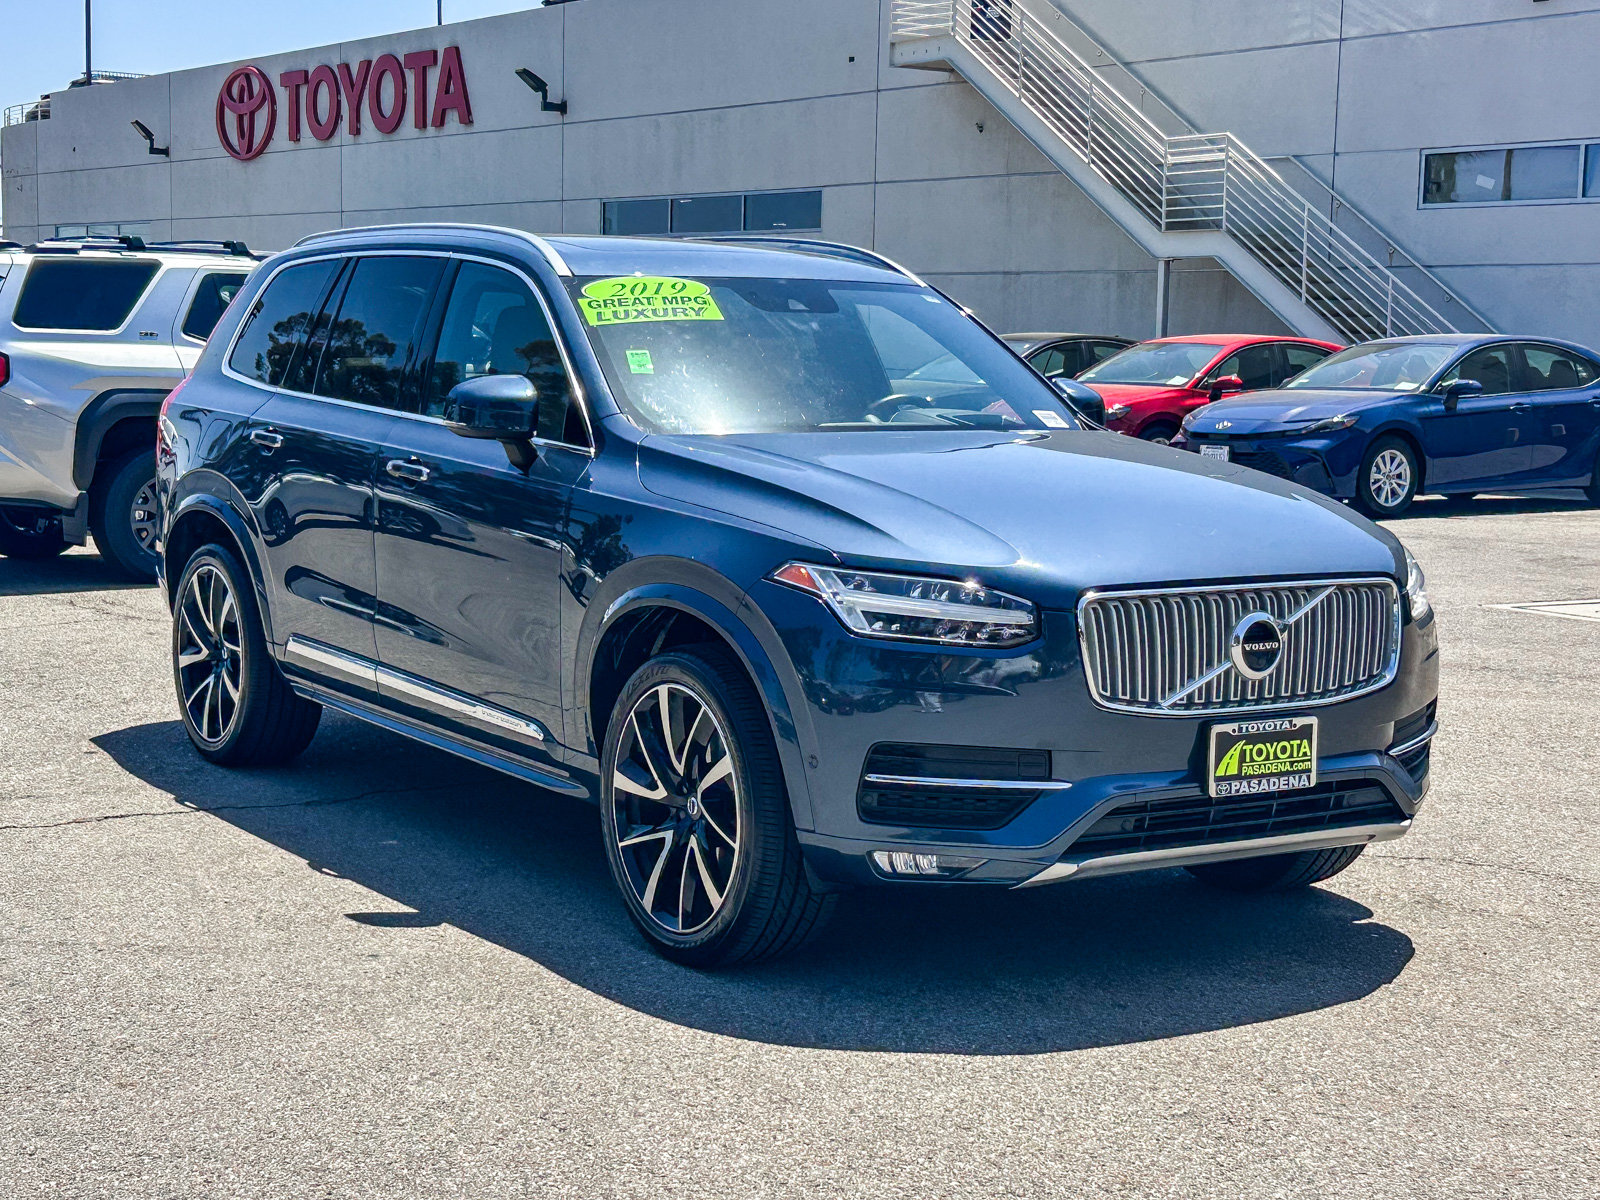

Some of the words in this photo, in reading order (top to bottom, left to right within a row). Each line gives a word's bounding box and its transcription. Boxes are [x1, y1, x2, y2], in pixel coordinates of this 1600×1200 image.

[280, 46, 474, 142] TOYOTA
[610, 281, 688, 298] 2019
[587, 296, 656, 310] GREAT
[662, 295, 710, 306] MPG
[596, 306, 707, 322] LUXURY
[1243, 641, 1279, 651] VOLVO
[1240, 720, 1291, 733] TOYOTA
[1242, 739, 1311, 762] TOYOTA
[1241, 761, 1311, 776] PASADENA.com
[1231, 775, 1310, 794] PASADENA
